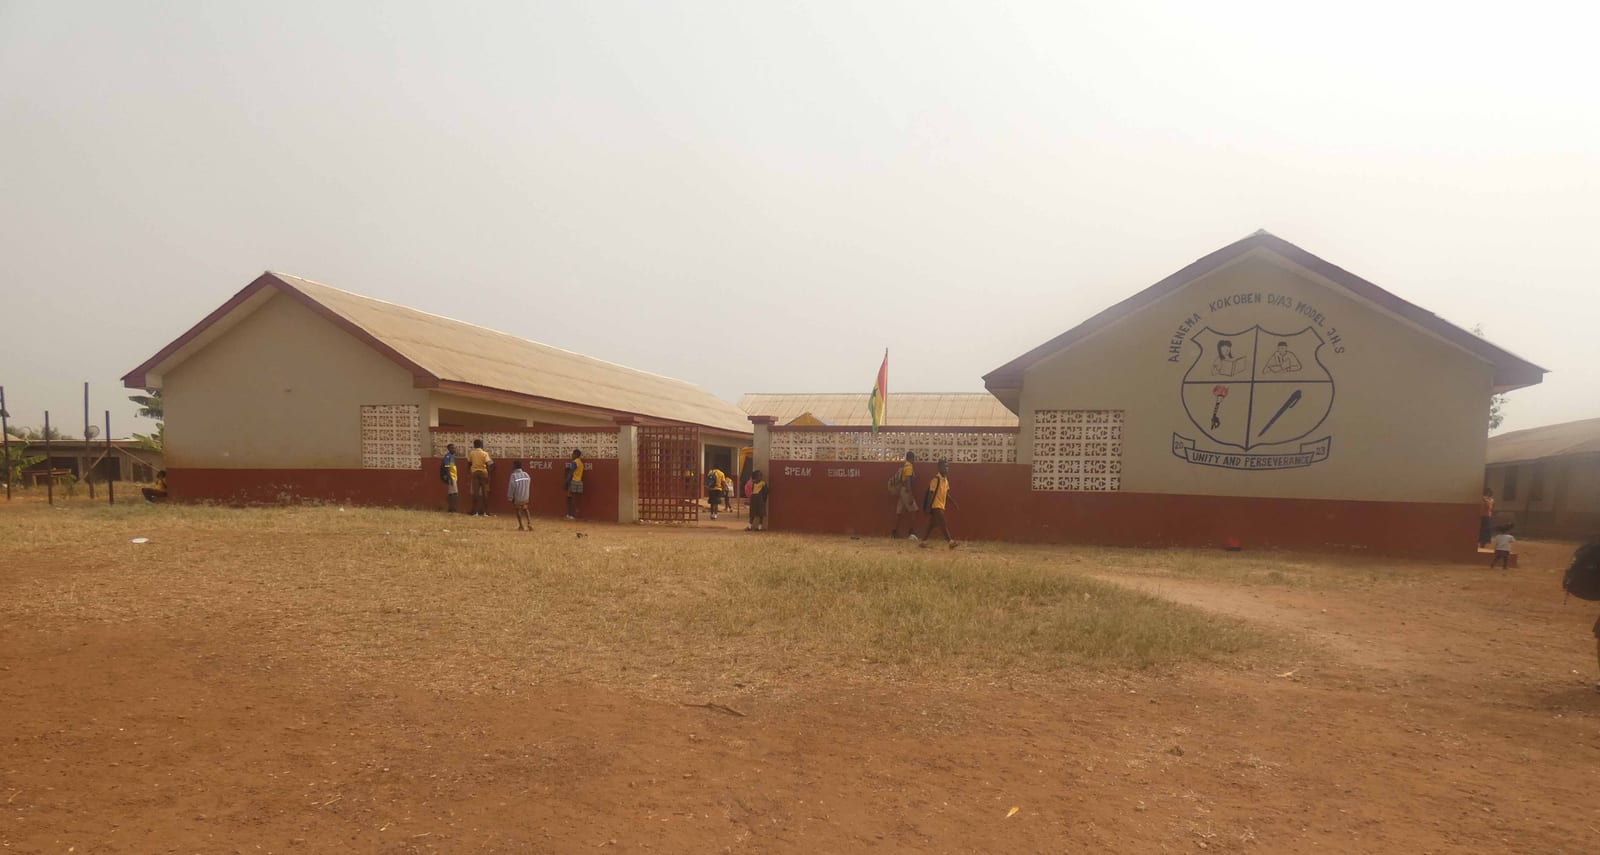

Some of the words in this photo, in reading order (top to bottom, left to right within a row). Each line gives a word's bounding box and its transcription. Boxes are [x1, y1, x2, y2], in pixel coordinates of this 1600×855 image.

[1168, 312, 1201, 363] AHENEMA
[1209, 293, 1261, 312] KOKOBEN
[1295, 301, 1326, 328] MODEL
[529, 461, 552, 470] SPEAK
[1192, 453, 1220, 465] UNITY
[1223, 456, 1241, 467] AND
[1244, 455, 1310, 467] PERSEVERANCE
[784, 466, 812, 476] SPEAK
[828, 467, 860, 477] ENGLISH
